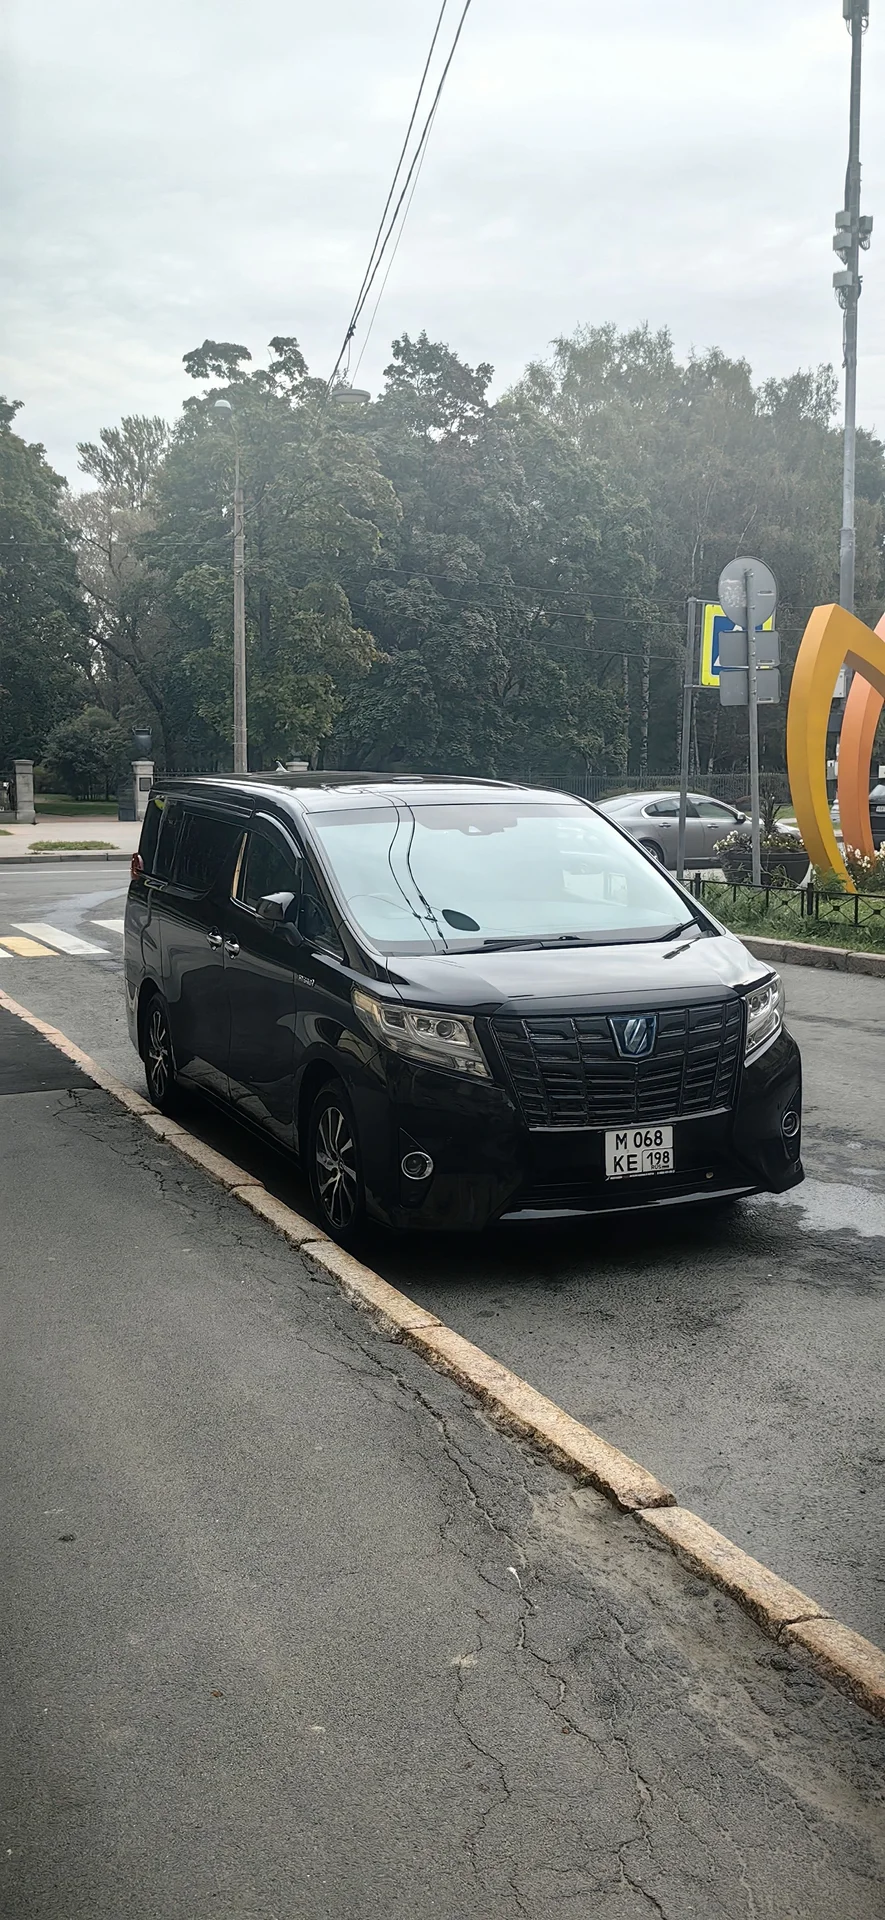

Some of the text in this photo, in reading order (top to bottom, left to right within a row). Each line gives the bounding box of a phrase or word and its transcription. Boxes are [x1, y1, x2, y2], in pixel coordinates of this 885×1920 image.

[615, 1129, 663, 1150] M 068
[613, 1150, 670, 1173] KE 198
